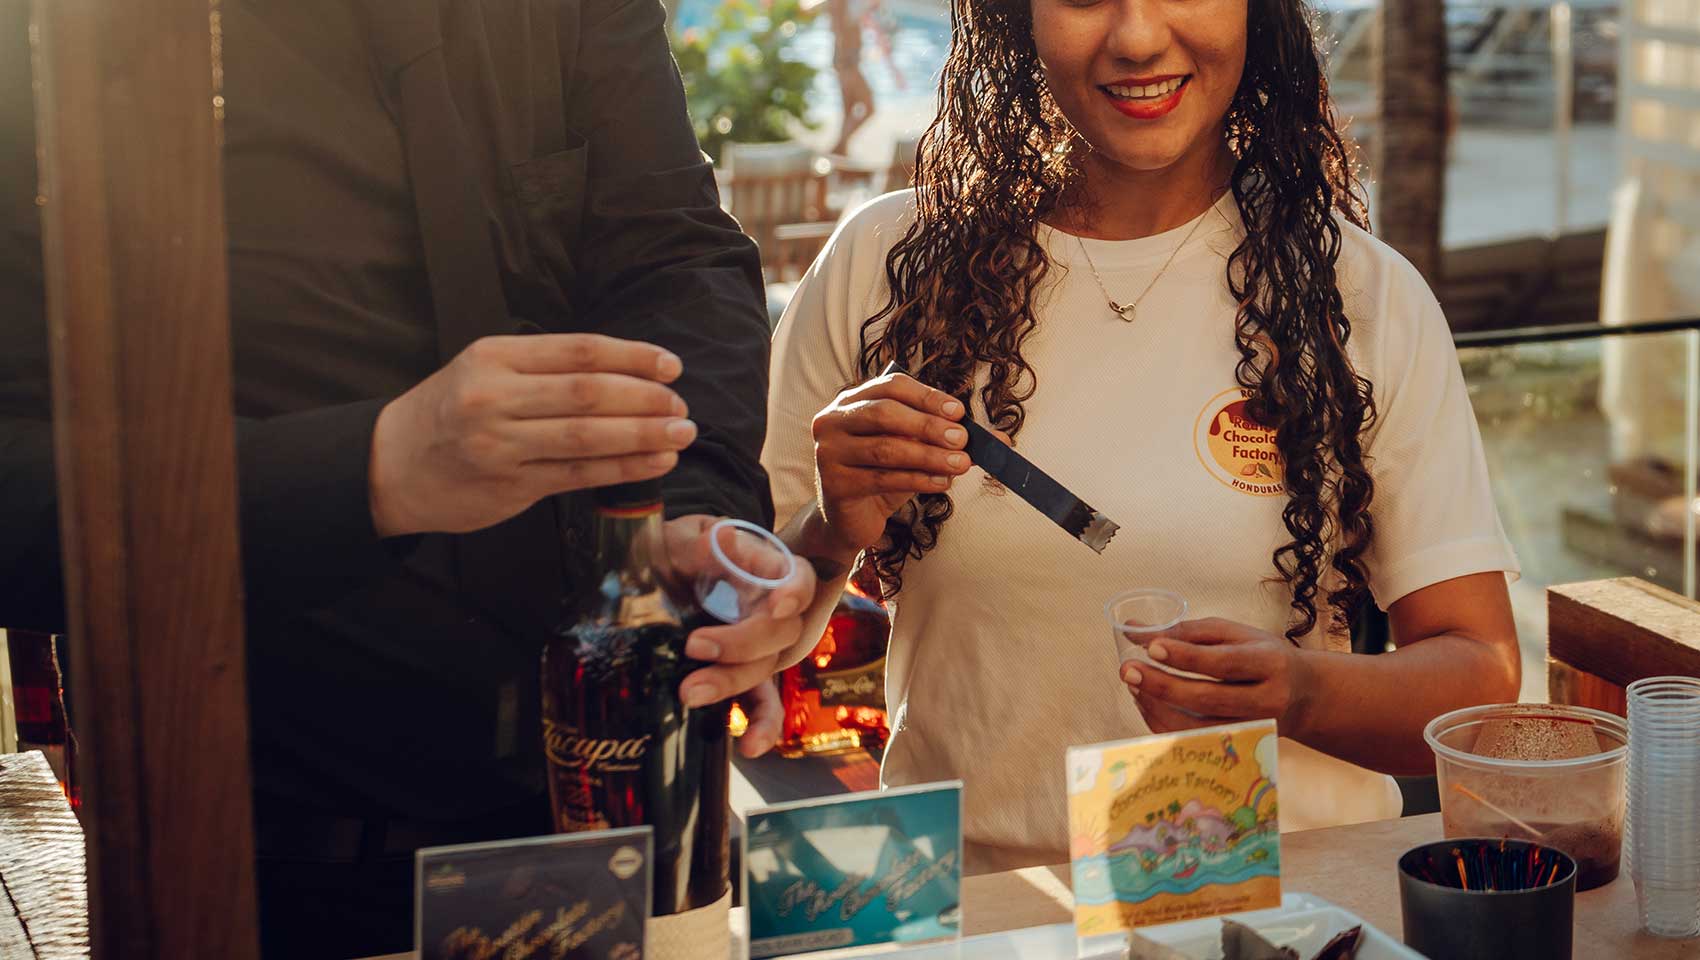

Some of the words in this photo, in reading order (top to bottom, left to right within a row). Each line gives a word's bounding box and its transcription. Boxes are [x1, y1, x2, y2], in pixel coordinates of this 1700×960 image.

[1223, 430, 1277, 444] Chocola
[1233, 446, 1279, 465] Factory
[1232, 479, 1283, 494] HONDURAS
[1110, 776, 1179, 821] Chocolate
[1185, 771, 1240, 804] Factory
